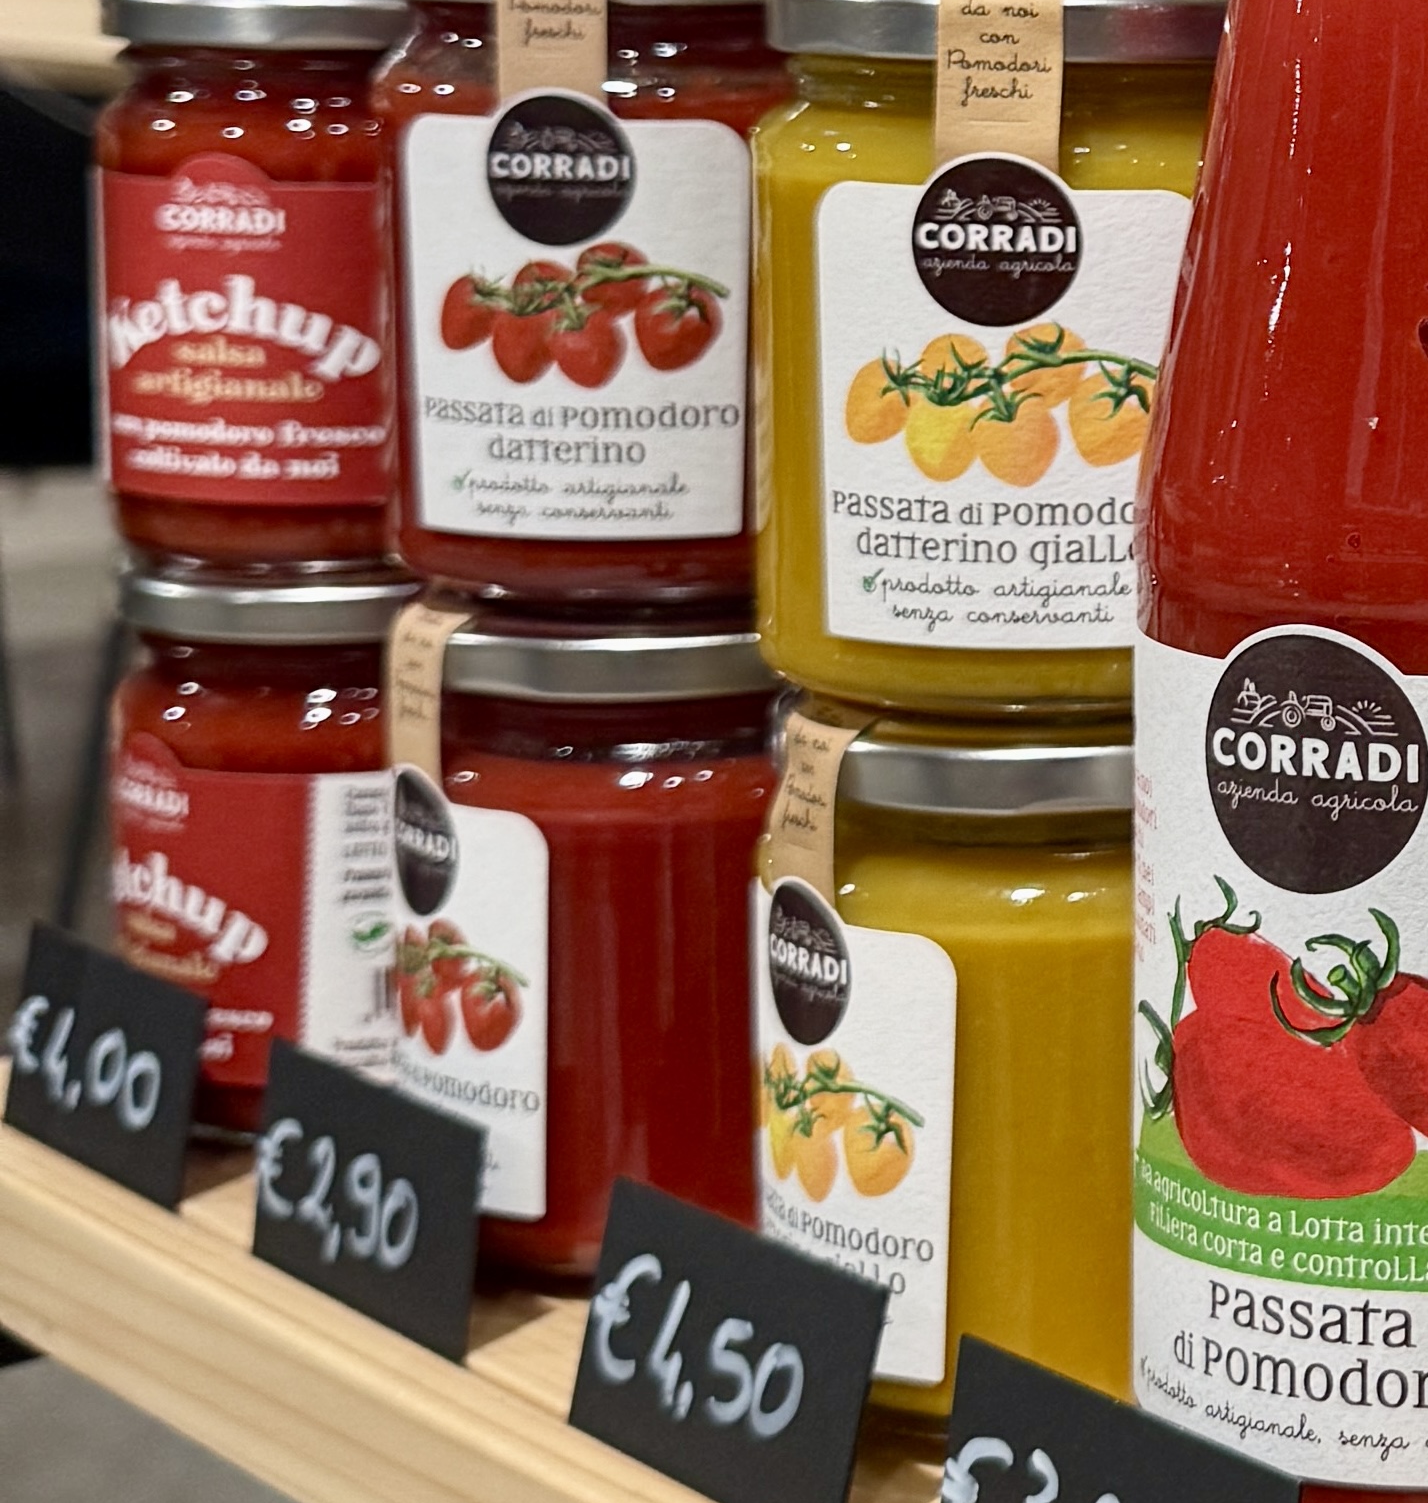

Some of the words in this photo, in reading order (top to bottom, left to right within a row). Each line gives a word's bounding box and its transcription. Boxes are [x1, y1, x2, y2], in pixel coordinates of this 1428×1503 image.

[1002, 2, 1039, 18] noi
[979, 32, 1020, 45] con
[946, 49, 1053, 73] Pomodori
[960, 75, 1034, 107] freschi
[490, 152, 630, 181] CORRADI
[154, 203, 286, 236] CORRADI
[918, 221, 1076, 253] CORRADI
[921, 253, 989, 277] azienda
[998, 252, 1075, 278] agricola
[487, 434, 646, 464] datterino
[959, 501, 983, 526] di
[856, 526, 1018, 563] datterino
[1029, 535, 1136, 570] giall
[881, 572, 981, 602] prodotto
[993, 570, 1133, 609] artigianale
[892, 603, 954, 629] senza
[966, 602, 1115, 624] conservanti
[1212, 726, 1419, 784] CORRADI
[1217, 777, 1300, 810] azienda
[1310, 784, 1419, 822] agricola
[769, 932, 848, 986] CORRADI
[6, 994, 163, 1131] €4,00
[256, 1116, 419, 1271] €2,90
[1153, 1170, 1260, 1229] agricoltura
[1290, 1211, 1365, 1244] lotta
[1203, 1224, 1264, 1266] corta
[1271, 1247, 1286, 1268] e
[593, 1251, 805, 1441] €4,50
[1173, 1329, 1196, 1370] di
[1145, 1364, 1198, 1409] prodotto
[1204, 1402, 1322, 1445] artigianale,
[1338, 1430, 1410, 1461] senza
